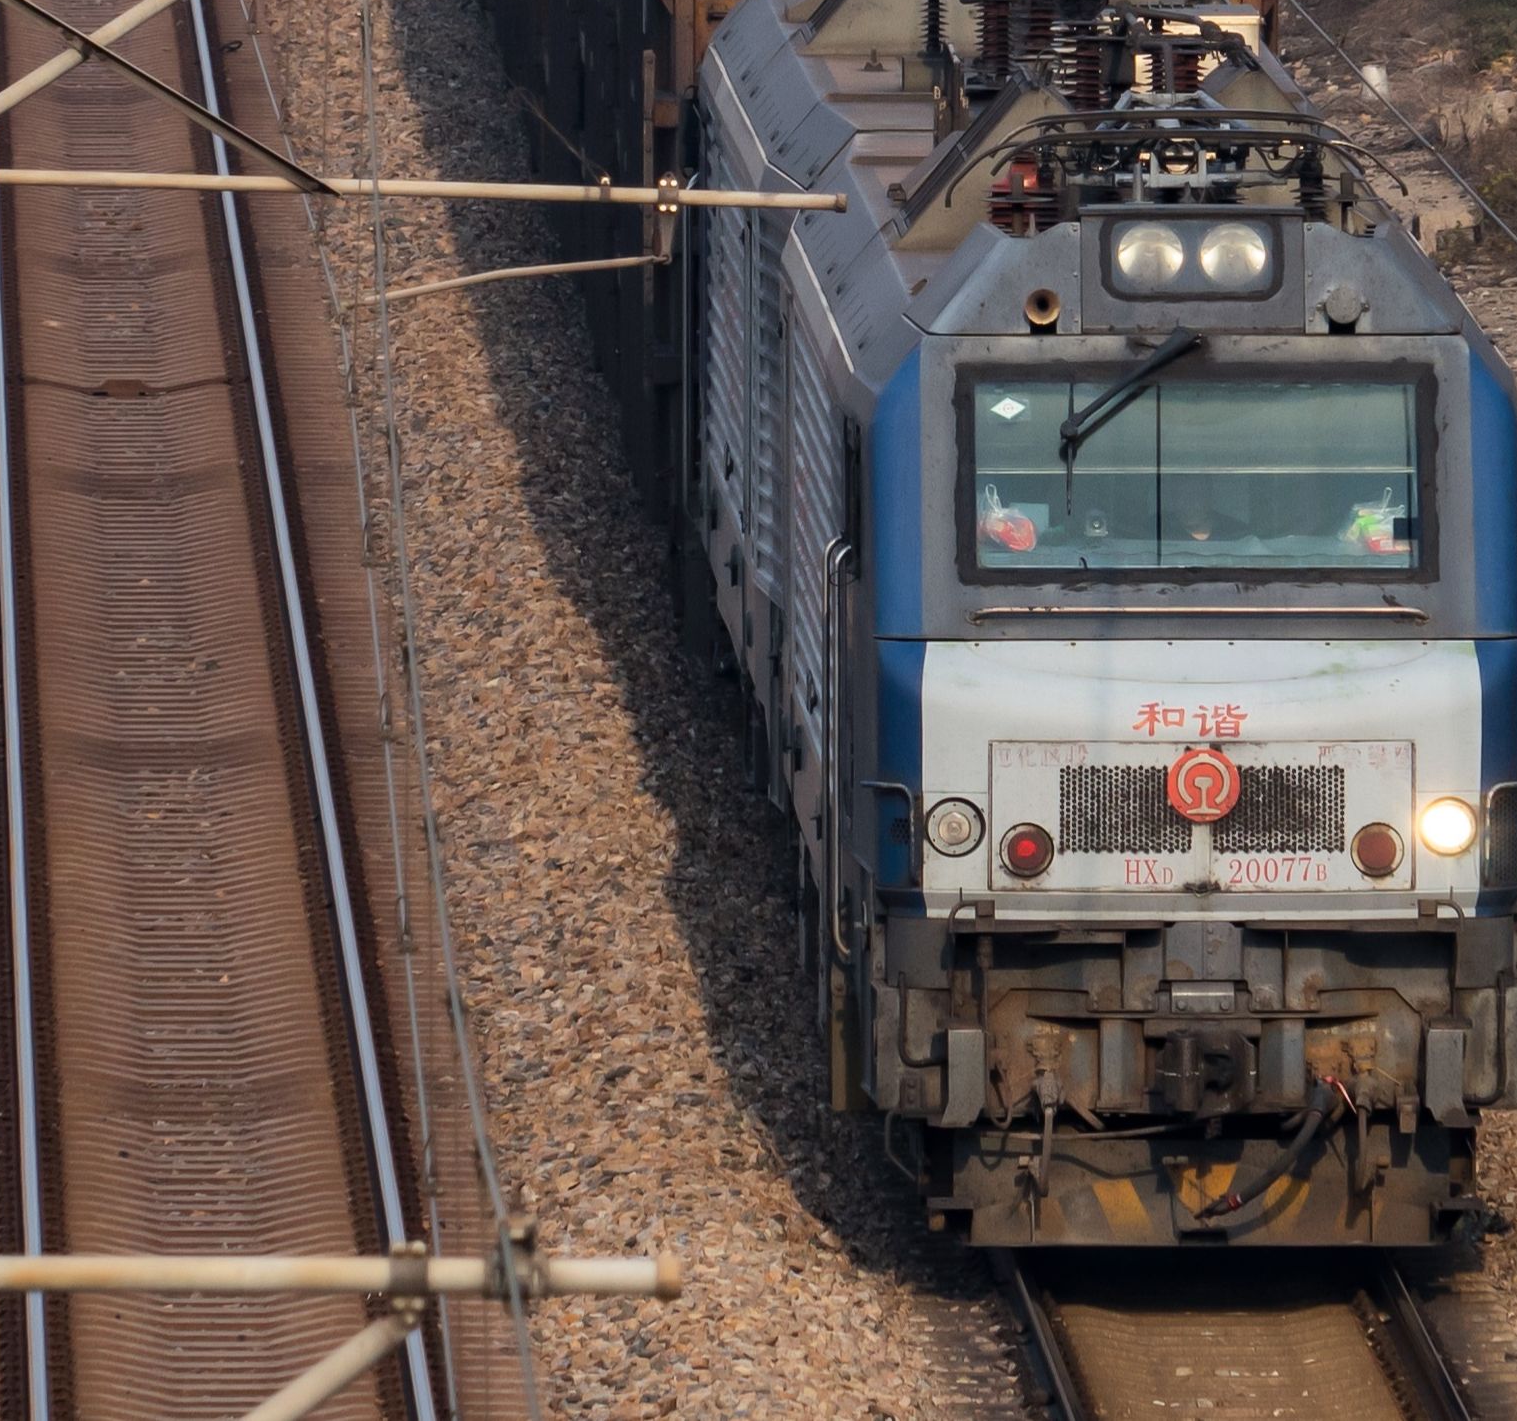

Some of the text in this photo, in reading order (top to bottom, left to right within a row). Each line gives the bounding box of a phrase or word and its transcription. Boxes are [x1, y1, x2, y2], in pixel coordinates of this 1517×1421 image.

[1132, 702, 1249, 738] 和谐
[1124, 857, 1328, 885] HXD 20077B
